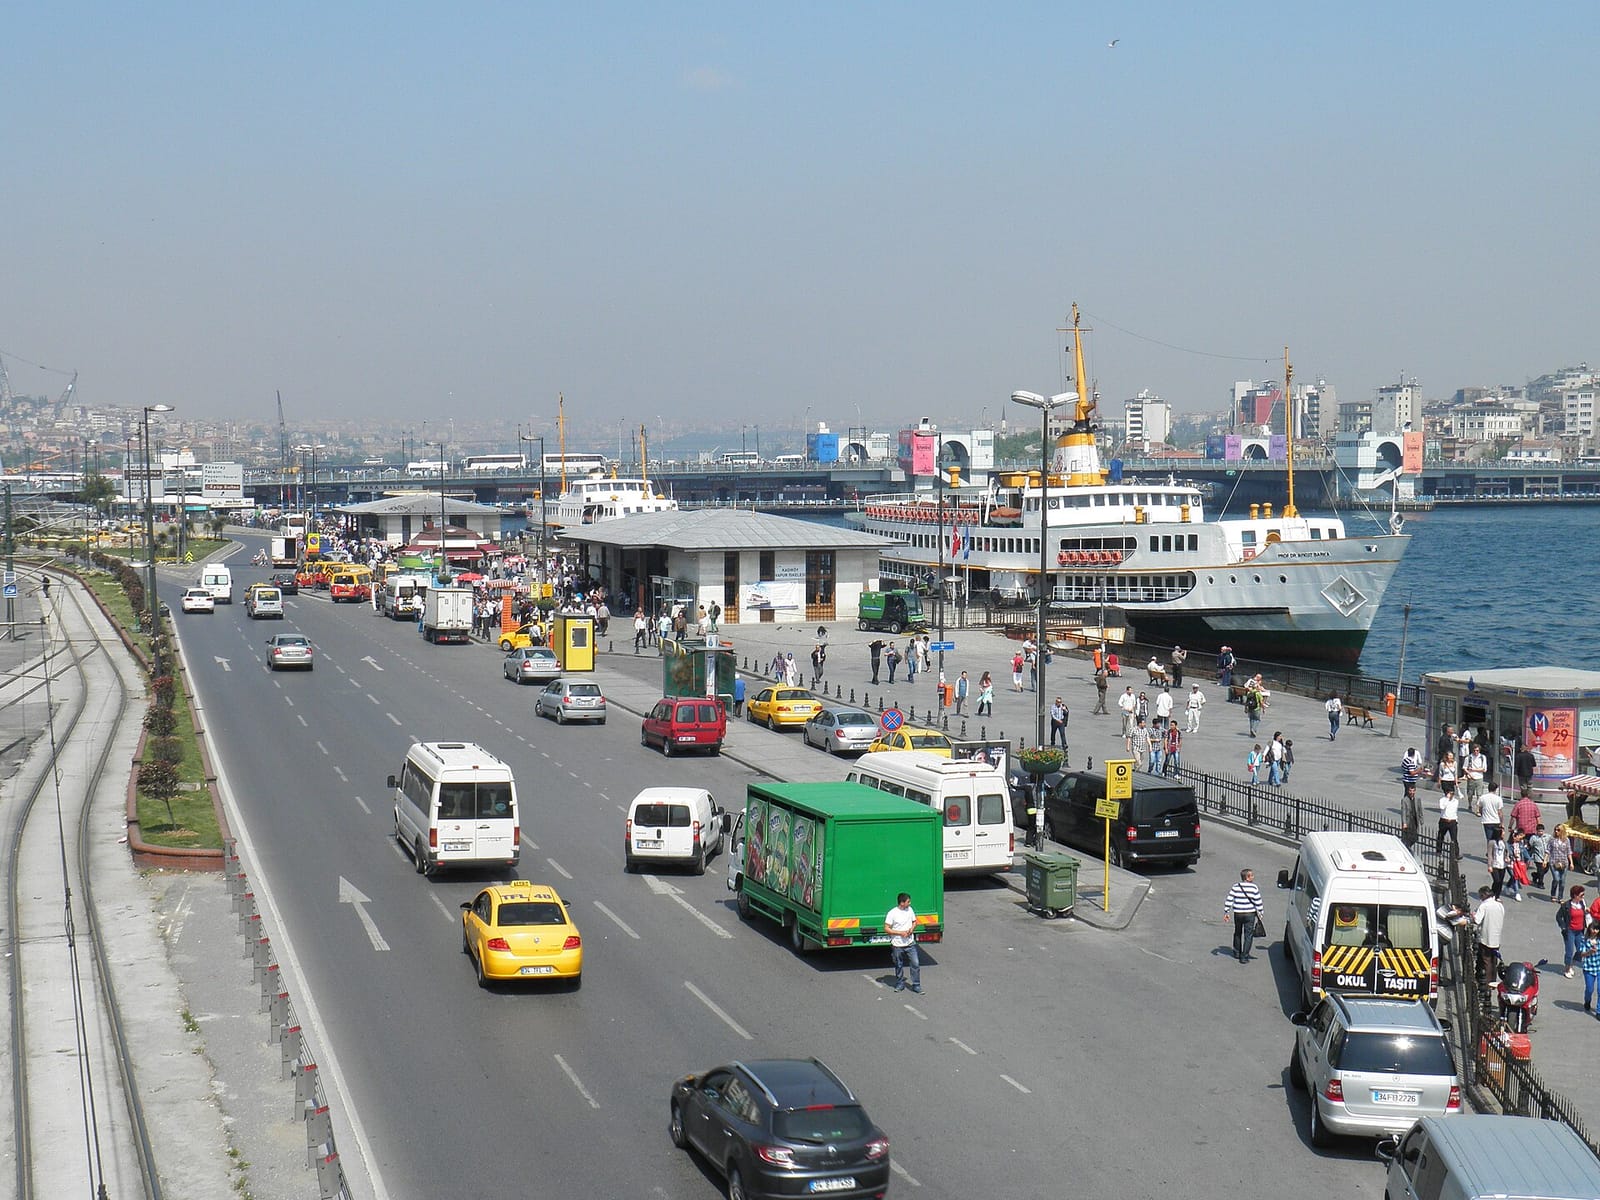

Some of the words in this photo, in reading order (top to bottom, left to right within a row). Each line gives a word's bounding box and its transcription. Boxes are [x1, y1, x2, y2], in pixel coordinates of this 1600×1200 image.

[1552, 729, 1569, 742] 29
[1337, 975, 1367, 987] OKUL
[1383, 978, 1417, 990] TAŞITI
